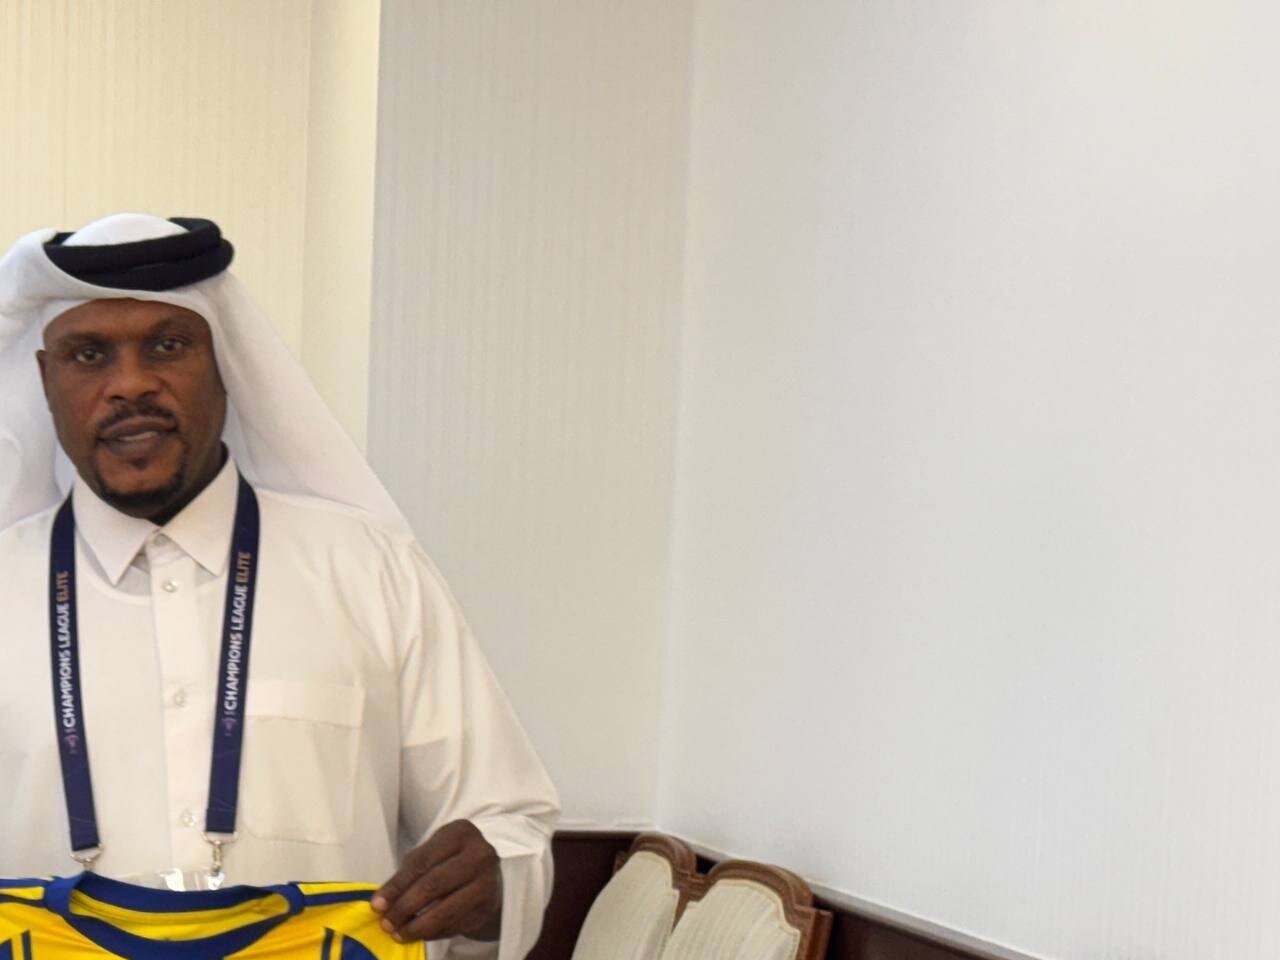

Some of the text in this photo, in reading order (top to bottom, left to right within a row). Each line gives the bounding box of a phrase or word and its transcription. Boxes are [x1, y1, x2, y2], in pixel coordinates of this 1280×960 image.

[55, 570, 77, 728] CHAMPIONS LEAGUE ELITE
[223, 551, 252, 711] CHAMPIONS LEAGUE ELITE
